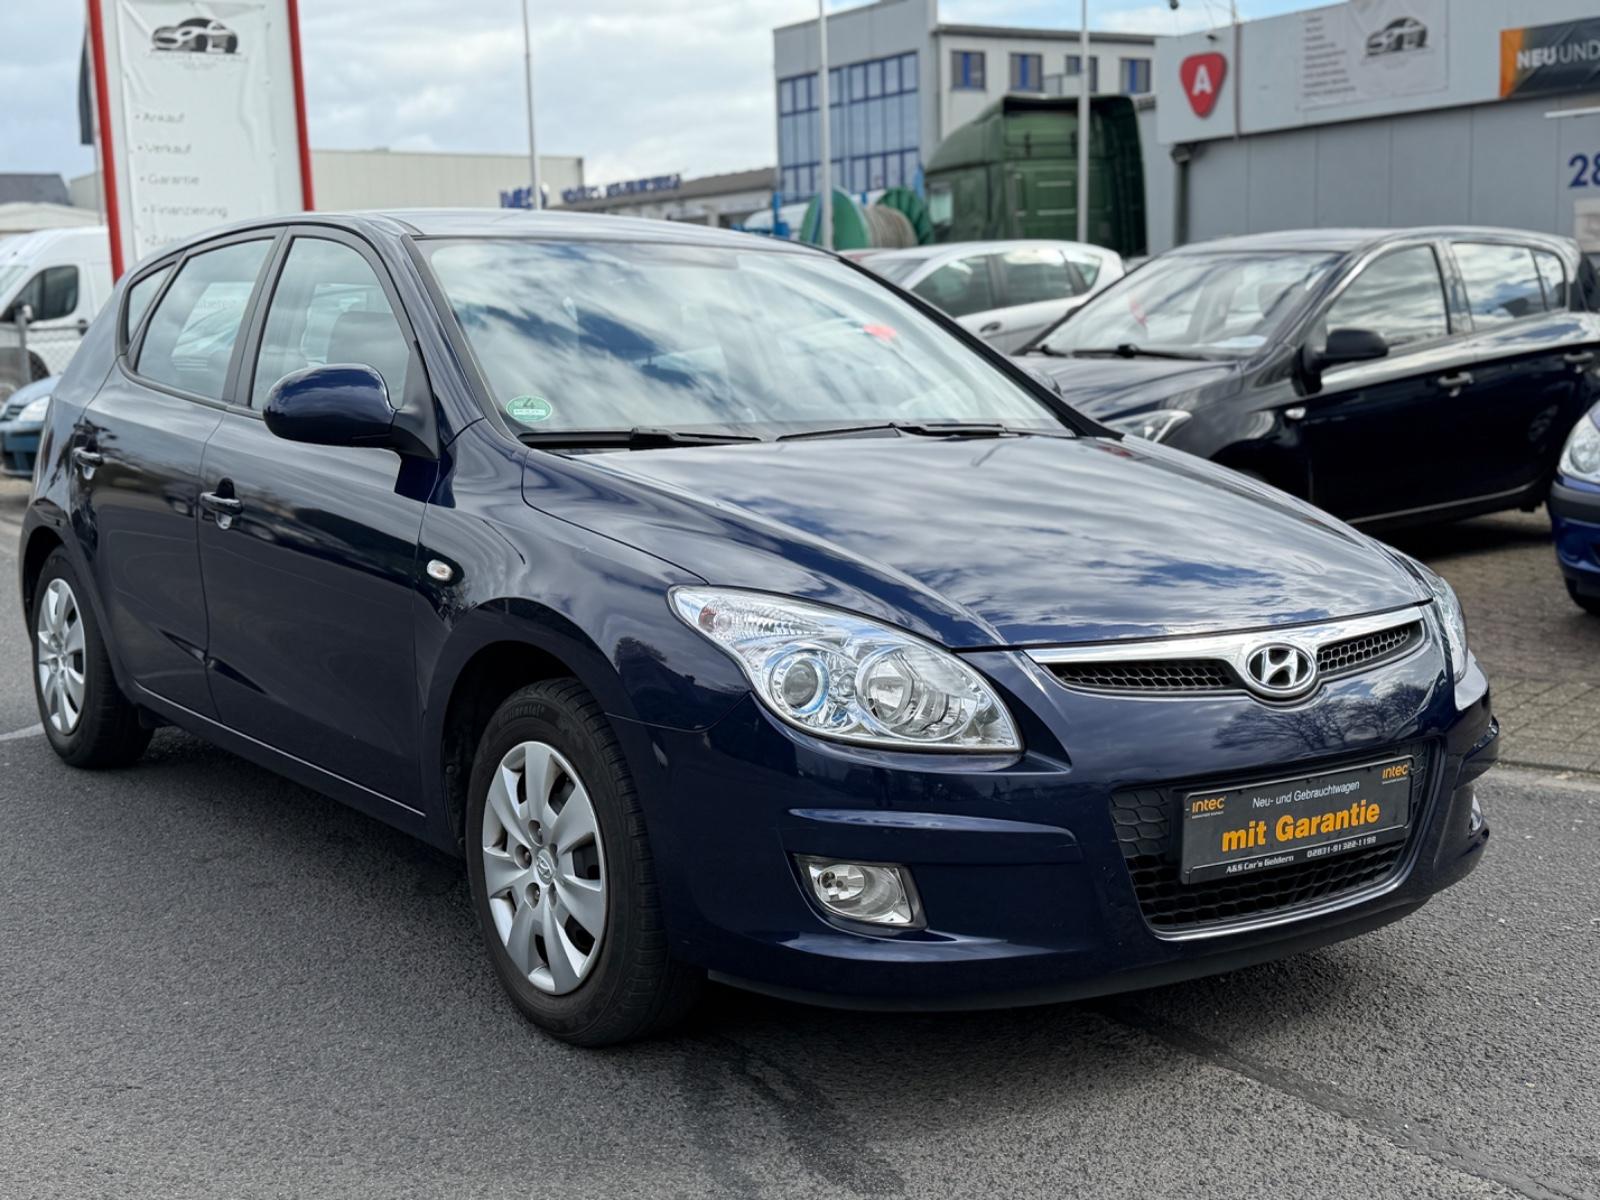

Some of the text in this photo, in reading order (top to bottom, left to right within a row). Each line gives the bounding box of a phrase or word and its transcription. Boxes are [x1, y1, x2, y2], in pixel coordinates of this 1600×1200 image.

[1191, 64, 1213, 96] A
[1252, 781, 1360, 809] Neu- und Gebrauchtwagen
[1221, 799, 1382, 852] mit Garantie
